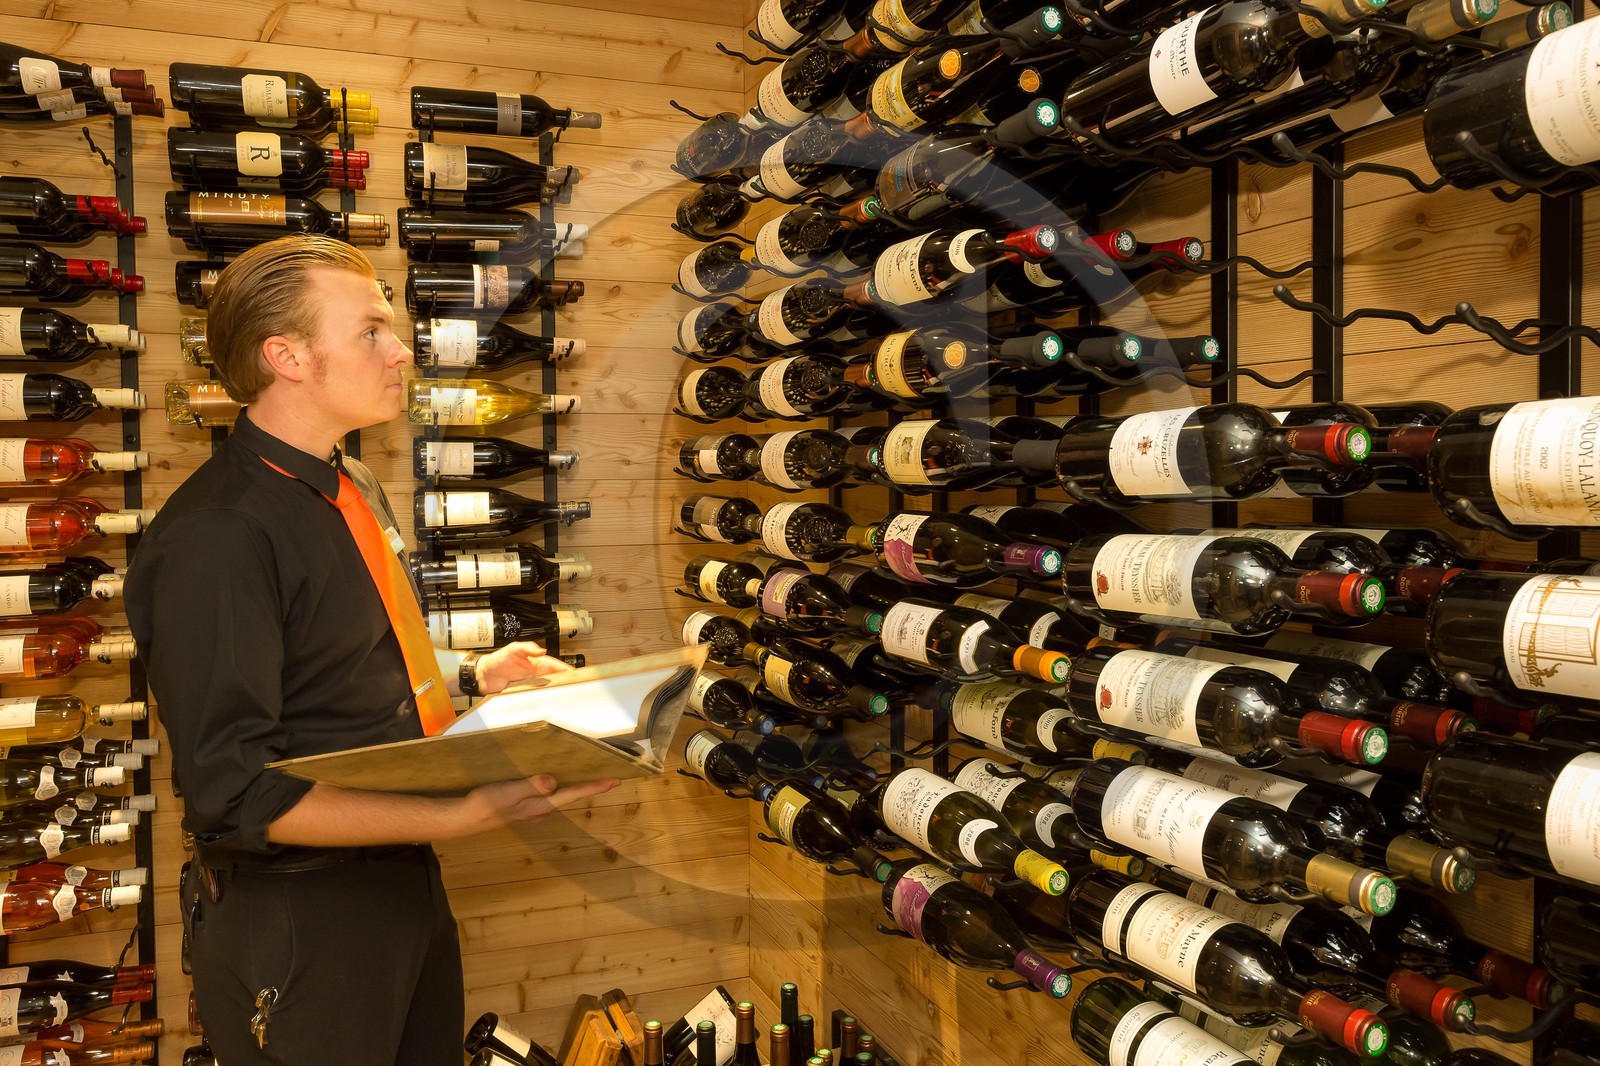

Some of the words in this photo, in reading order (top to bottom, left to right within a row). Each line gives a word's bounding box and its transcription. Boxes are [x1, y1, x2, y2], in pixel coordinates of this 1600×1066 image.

[1180, 17, 1193, 77] OURTHE
[250, 145, 271, 163] R
[198, 191, 271, 200] MINUTY
[954, 238, 963, 256] 2008
[1161, 427, 1173, 479] CRUZELLES
[1539, 446, 1549, 470] 2002
[1131, 562, 1142, 604] TEYSSIER
[1133, 680, 1149, 723] TEYSSIER
[1175, 928, 1199, 969] Mayne
